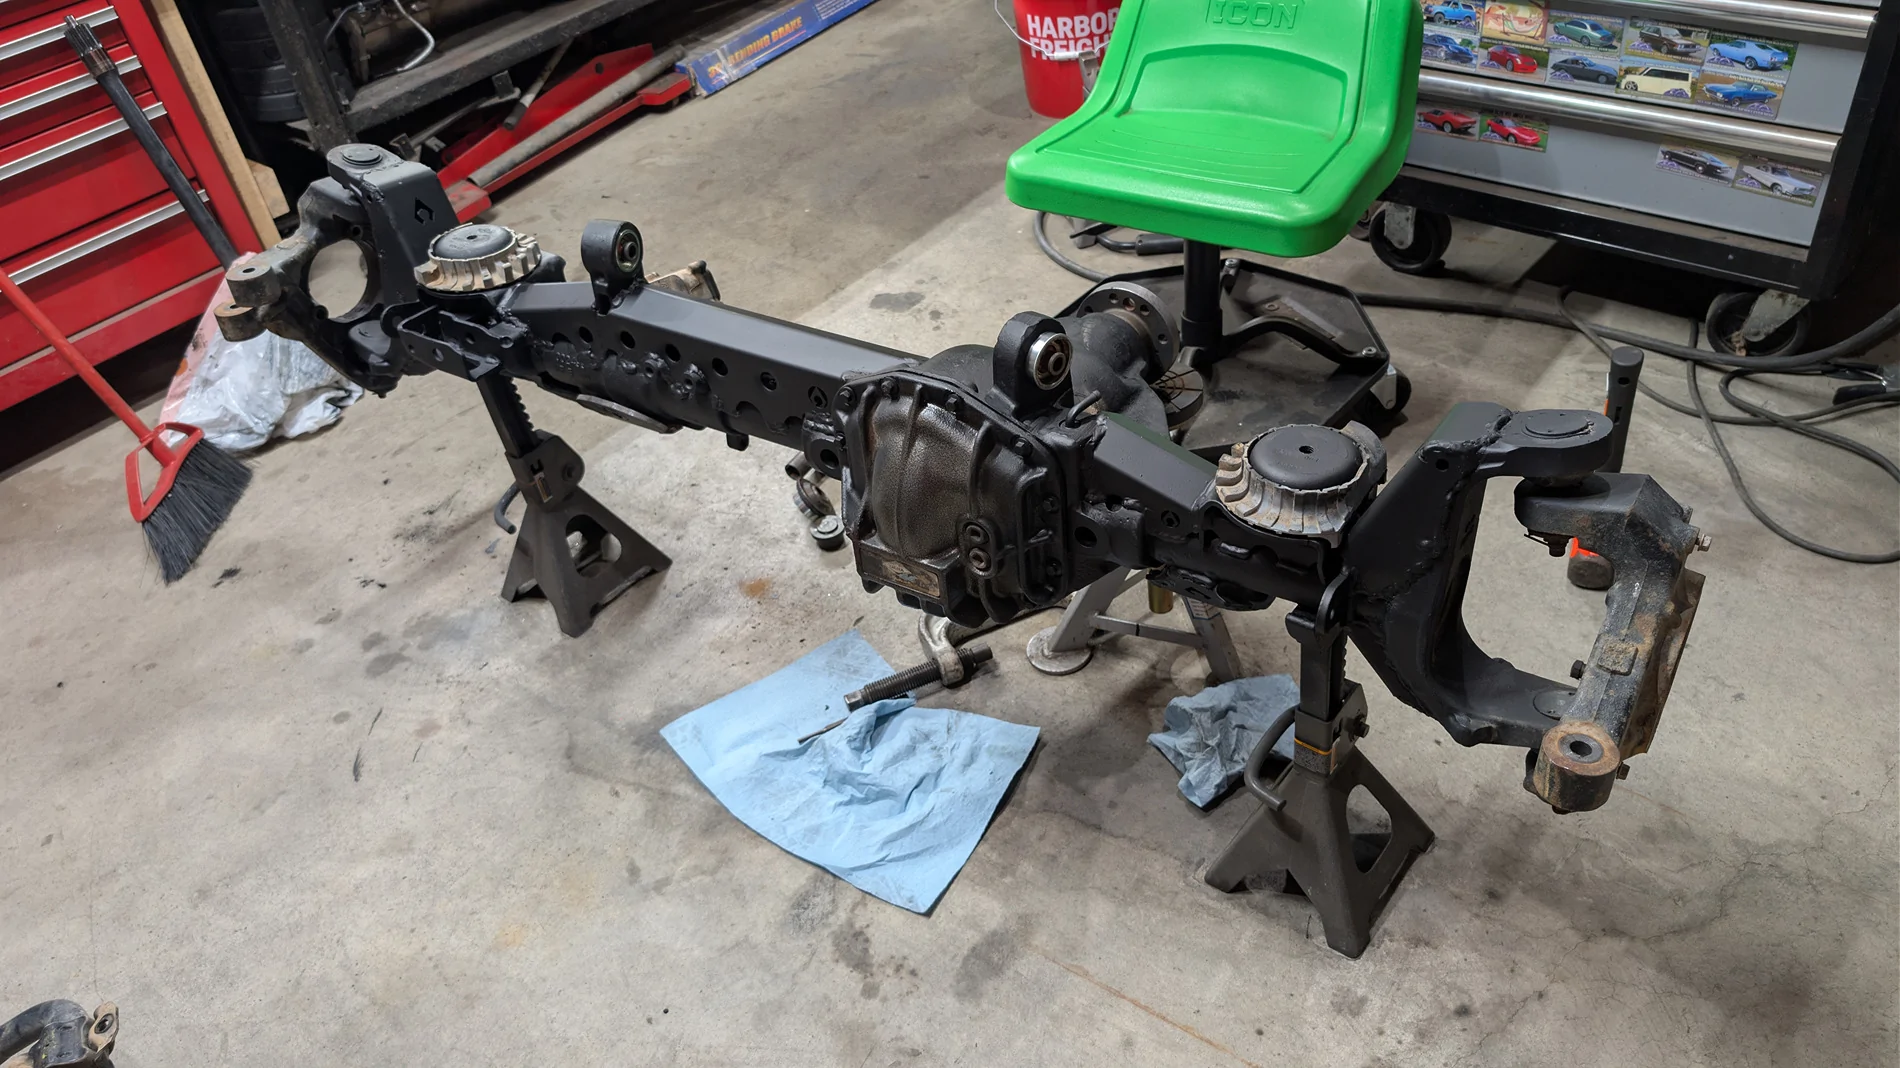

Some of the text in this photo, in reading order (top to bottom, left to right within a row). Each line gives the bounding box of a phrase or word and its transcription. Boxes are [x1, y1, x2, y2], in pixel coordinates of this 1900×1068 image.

[1212, 0, 1298, 29] ICON
[728, 34, 771, 66] BENDING
[771, 16, 803, 42] BRAKE
